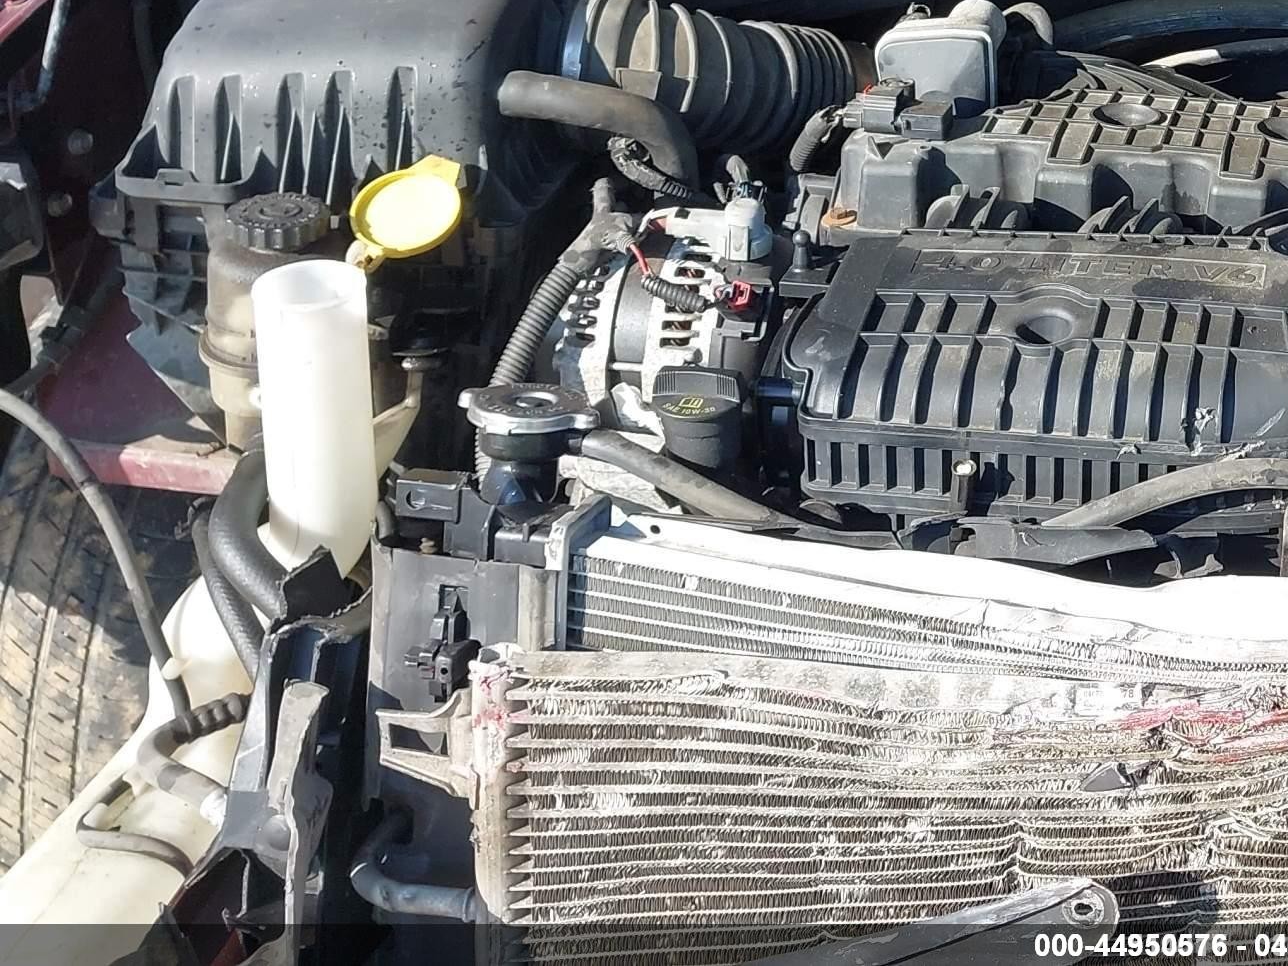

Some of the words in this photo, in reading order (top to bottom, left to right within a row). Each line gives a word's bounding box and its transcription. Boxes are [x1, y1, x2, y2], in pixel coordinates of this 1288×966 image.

[1017, 255, 1172, 279] LITER
[1194, 264, 1257, 285] V6
[662, 402, 681, 413] SAE
